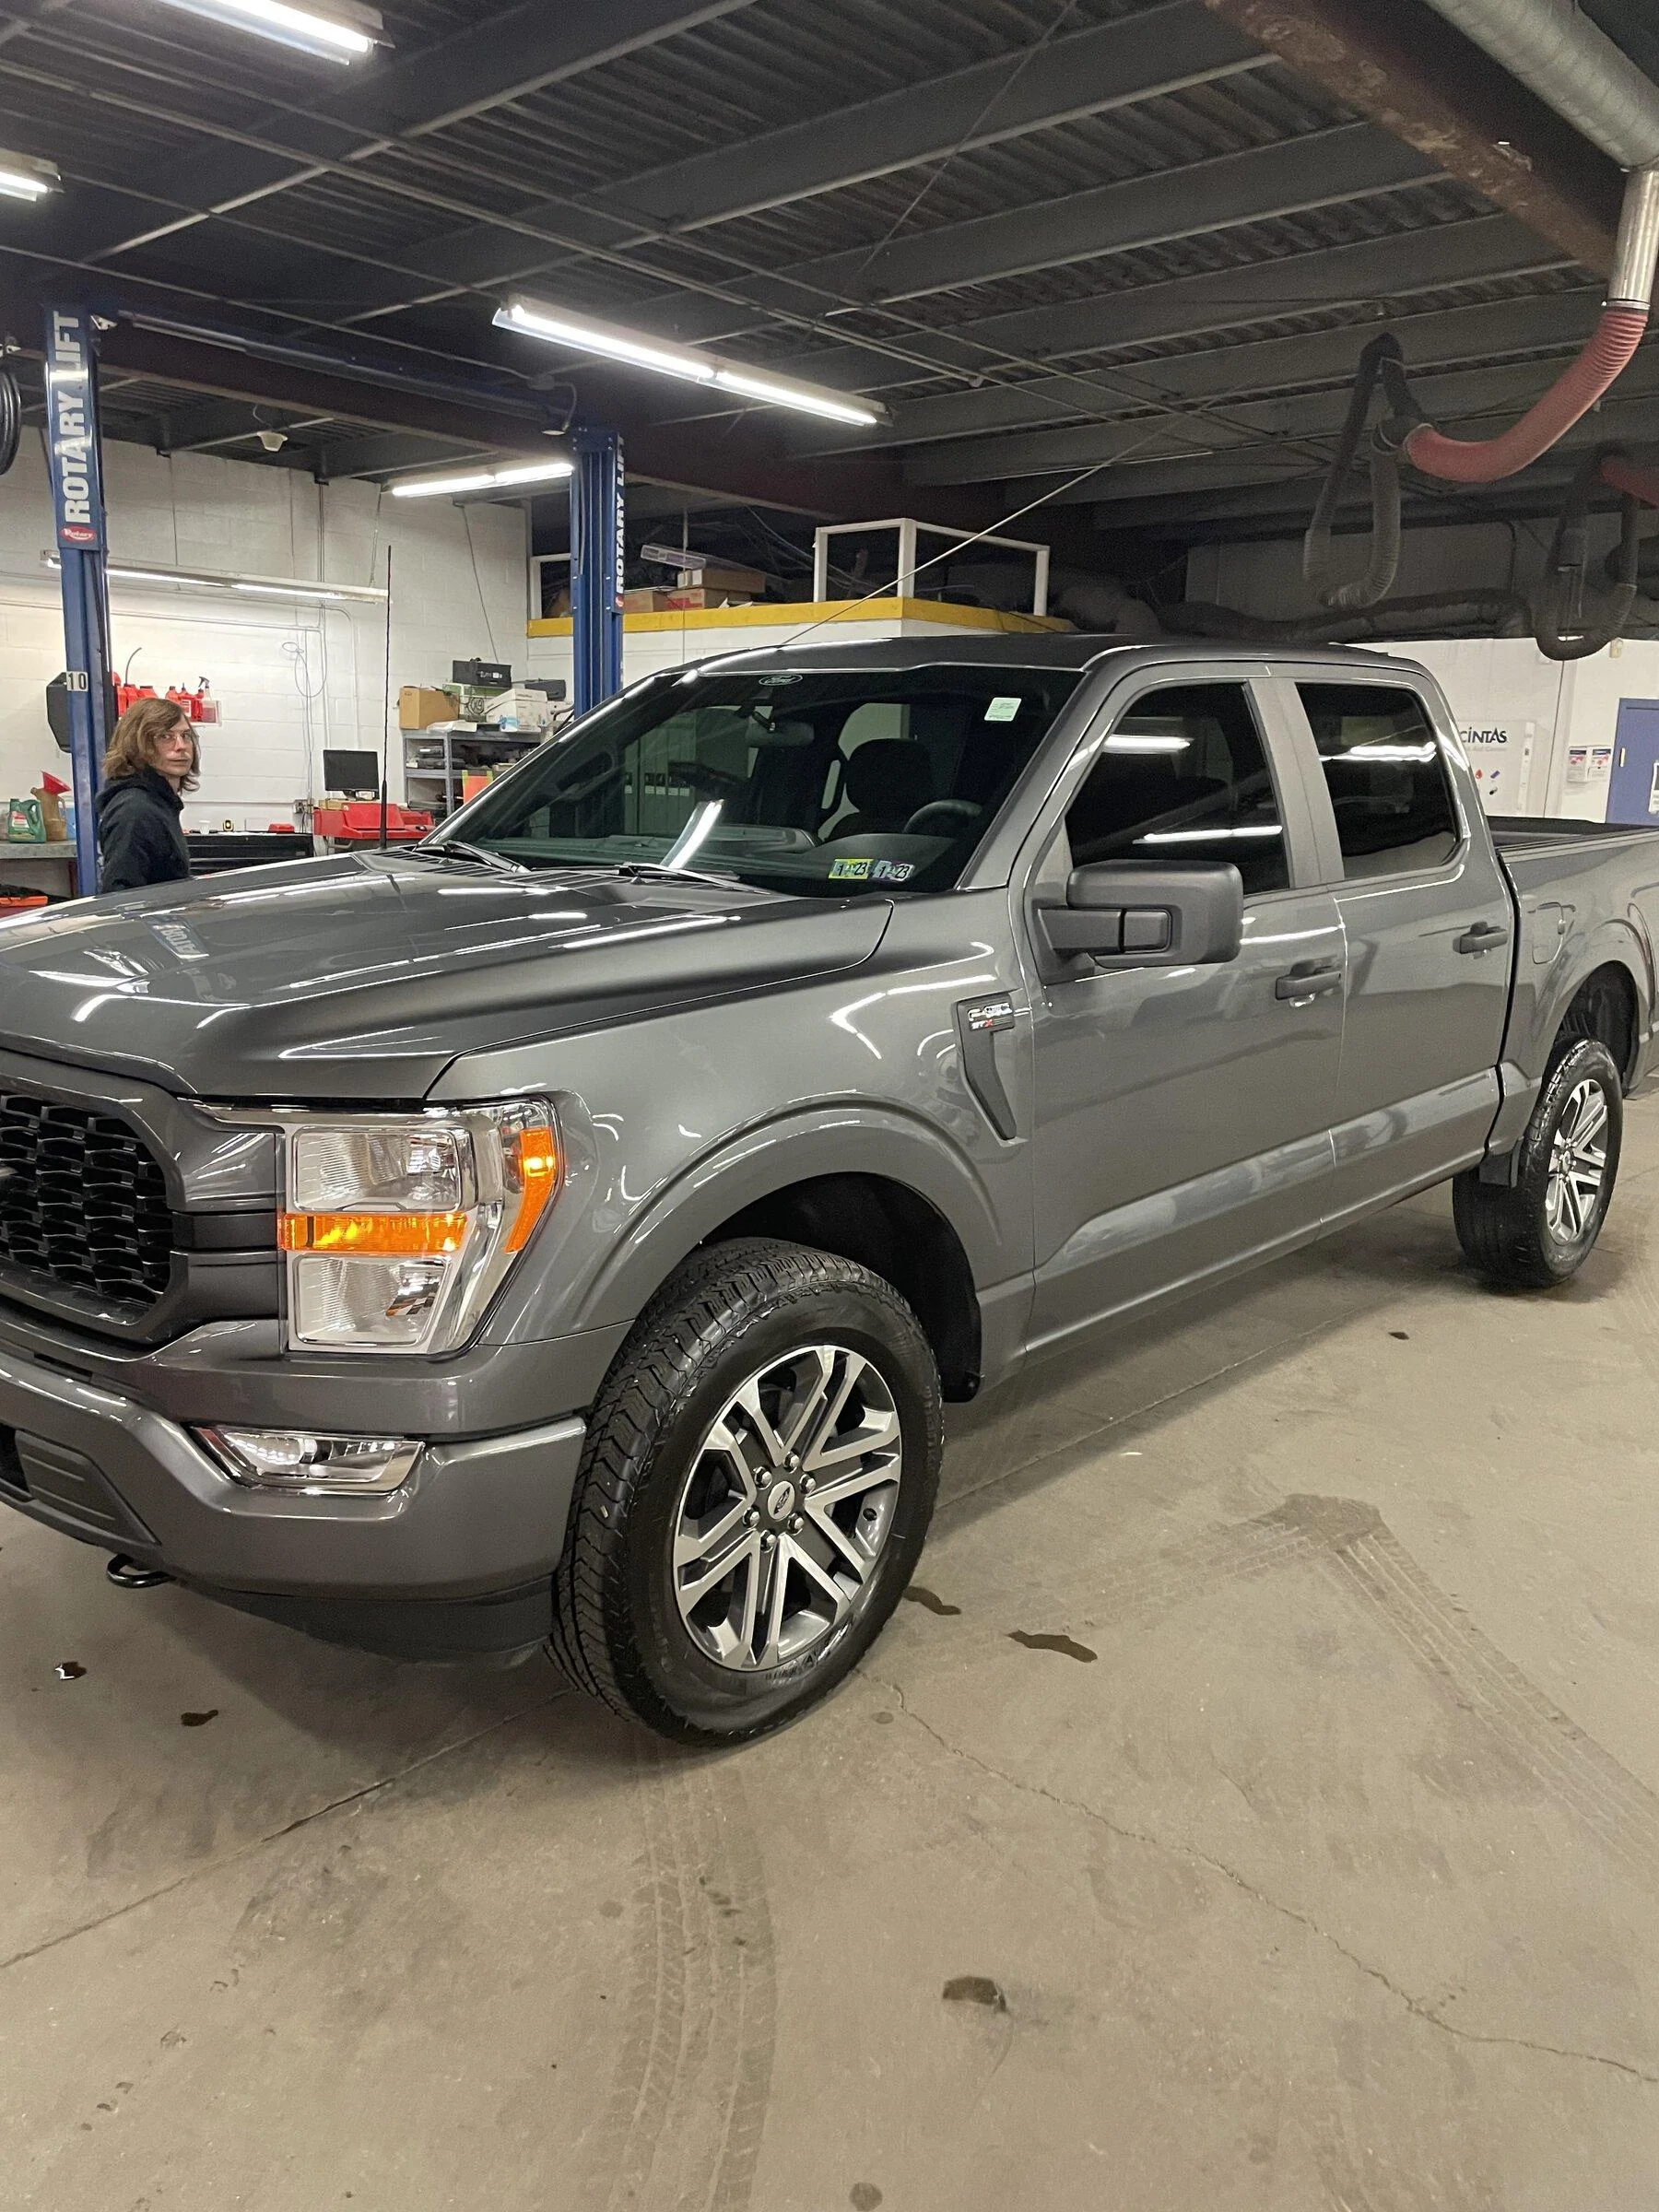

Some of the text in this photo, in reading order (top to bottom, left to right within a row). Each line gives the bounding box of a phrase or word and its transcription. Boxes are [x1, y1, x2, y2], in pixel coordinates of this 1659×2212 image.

[53, 311, 90, 524] ROTARY LIFT
[616, 492, 625, 594] ROTARY
[68, 673, 87, 690] 10
[853, 862, 868, 876] 23
[895, 865, 910, 879] 23
